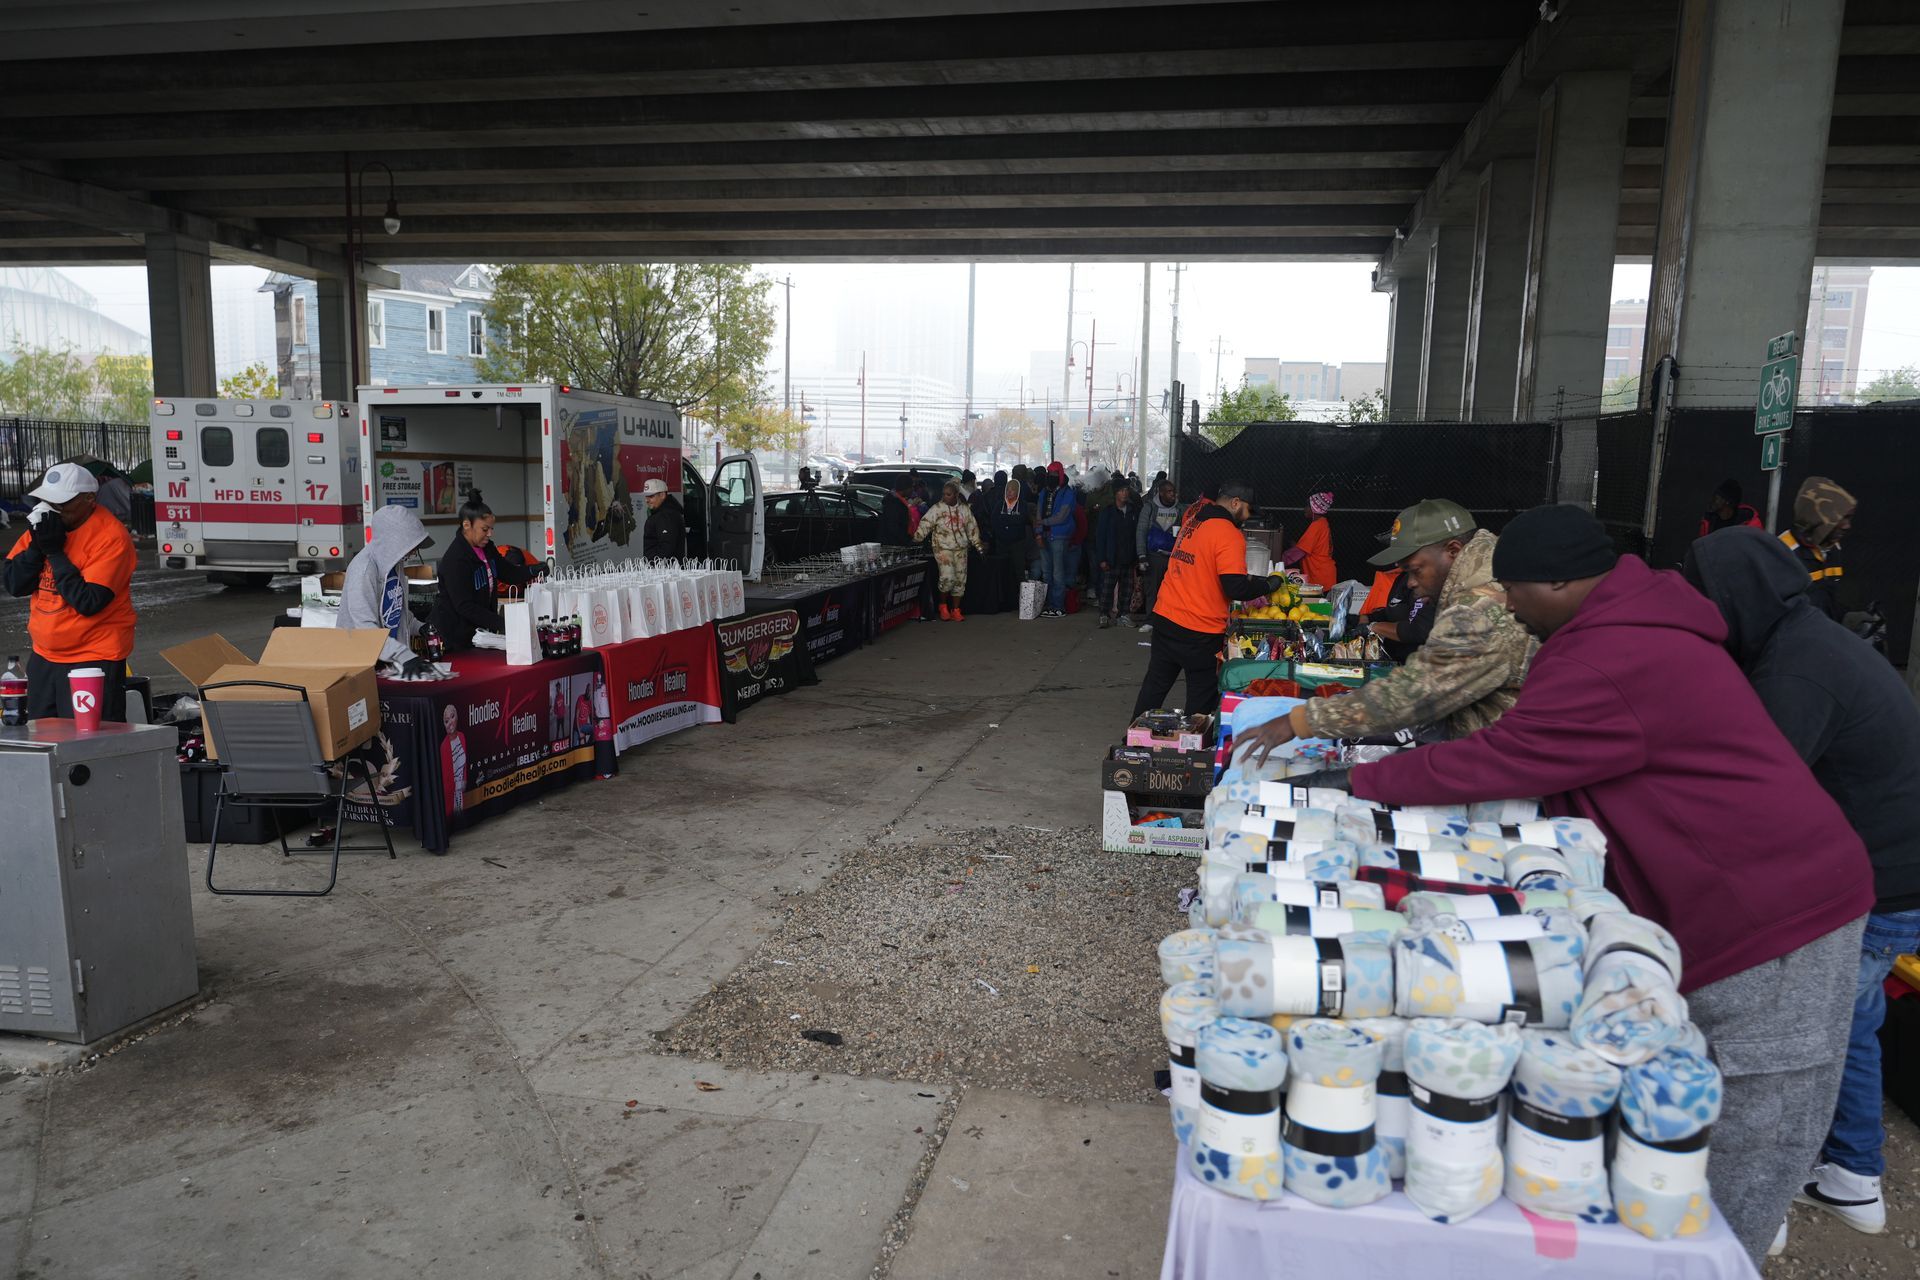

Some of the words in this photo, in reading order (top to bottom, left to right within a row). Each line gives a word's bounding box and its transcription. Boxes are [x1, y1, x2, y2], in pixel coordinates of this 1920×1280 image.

[1772, 339, 1789, 356] BEGIN
[623, 415, 674, 439] U-HAUL
[1758, 414, 1770, 428] BIKE
[345, 457, 357, 473] 17
[168, 482, 187, 498] M
[305, 484, 329, 500] 17
[382, 482, 397, 491] FREE
[397, 482, 421, 491] STORAGE
[214, 490, 245, 501] HFD
[250, 490, 282, 502] EMS
[167, 509, 191, 519] 911
[628, 679, 654, 702] Hoodies
[663, 671, 687, 692] Healing
[77, 695, 91, 708] K
[468, 698, 500, 727] Hoodies
[512, 712, 537, 735] Healing
[1168, 834, 1204, 844] ASPARAGUS
